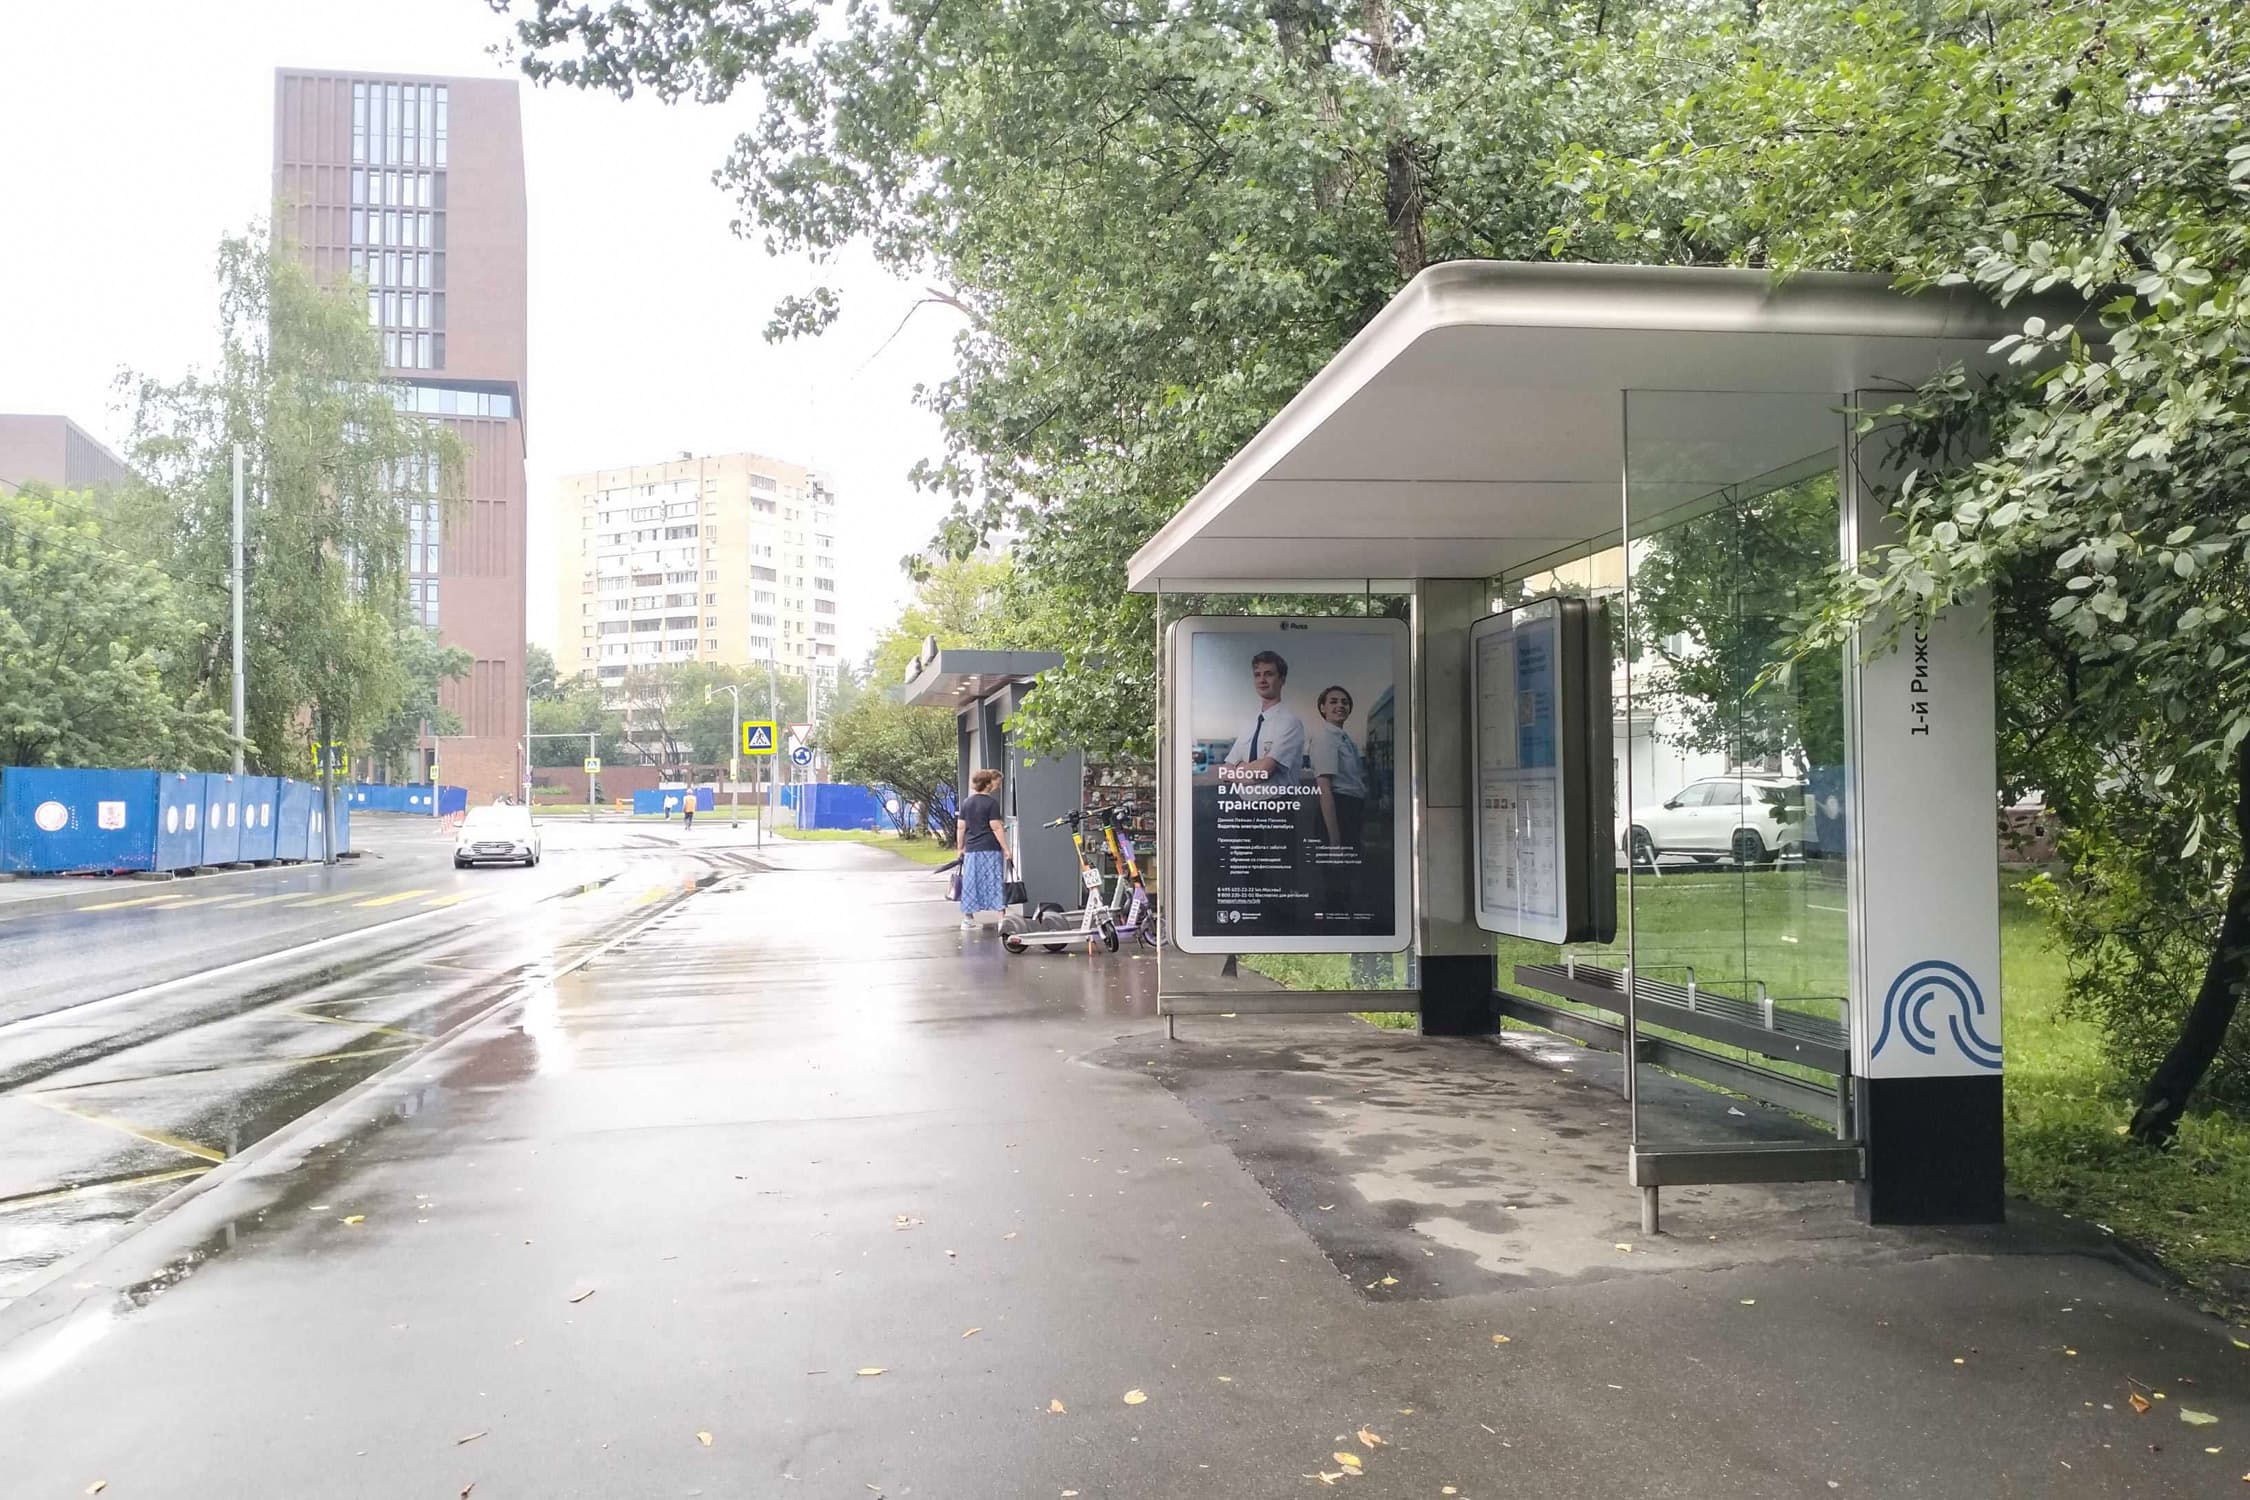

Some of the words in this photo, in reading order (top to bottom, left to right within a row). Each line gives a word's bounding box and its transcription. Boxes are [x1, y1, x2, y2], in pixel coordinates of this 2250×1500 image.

[1911, 592, 1928, 692] Рижс
[1911, 702, 1928, 735] 1-й
[1218, 766, 1269, 779] Работа
[1217, 785, 1227, 795] в
[1229, 782, 1322, 796] Московском
[1217, 800, 1301, 813] транспорте
